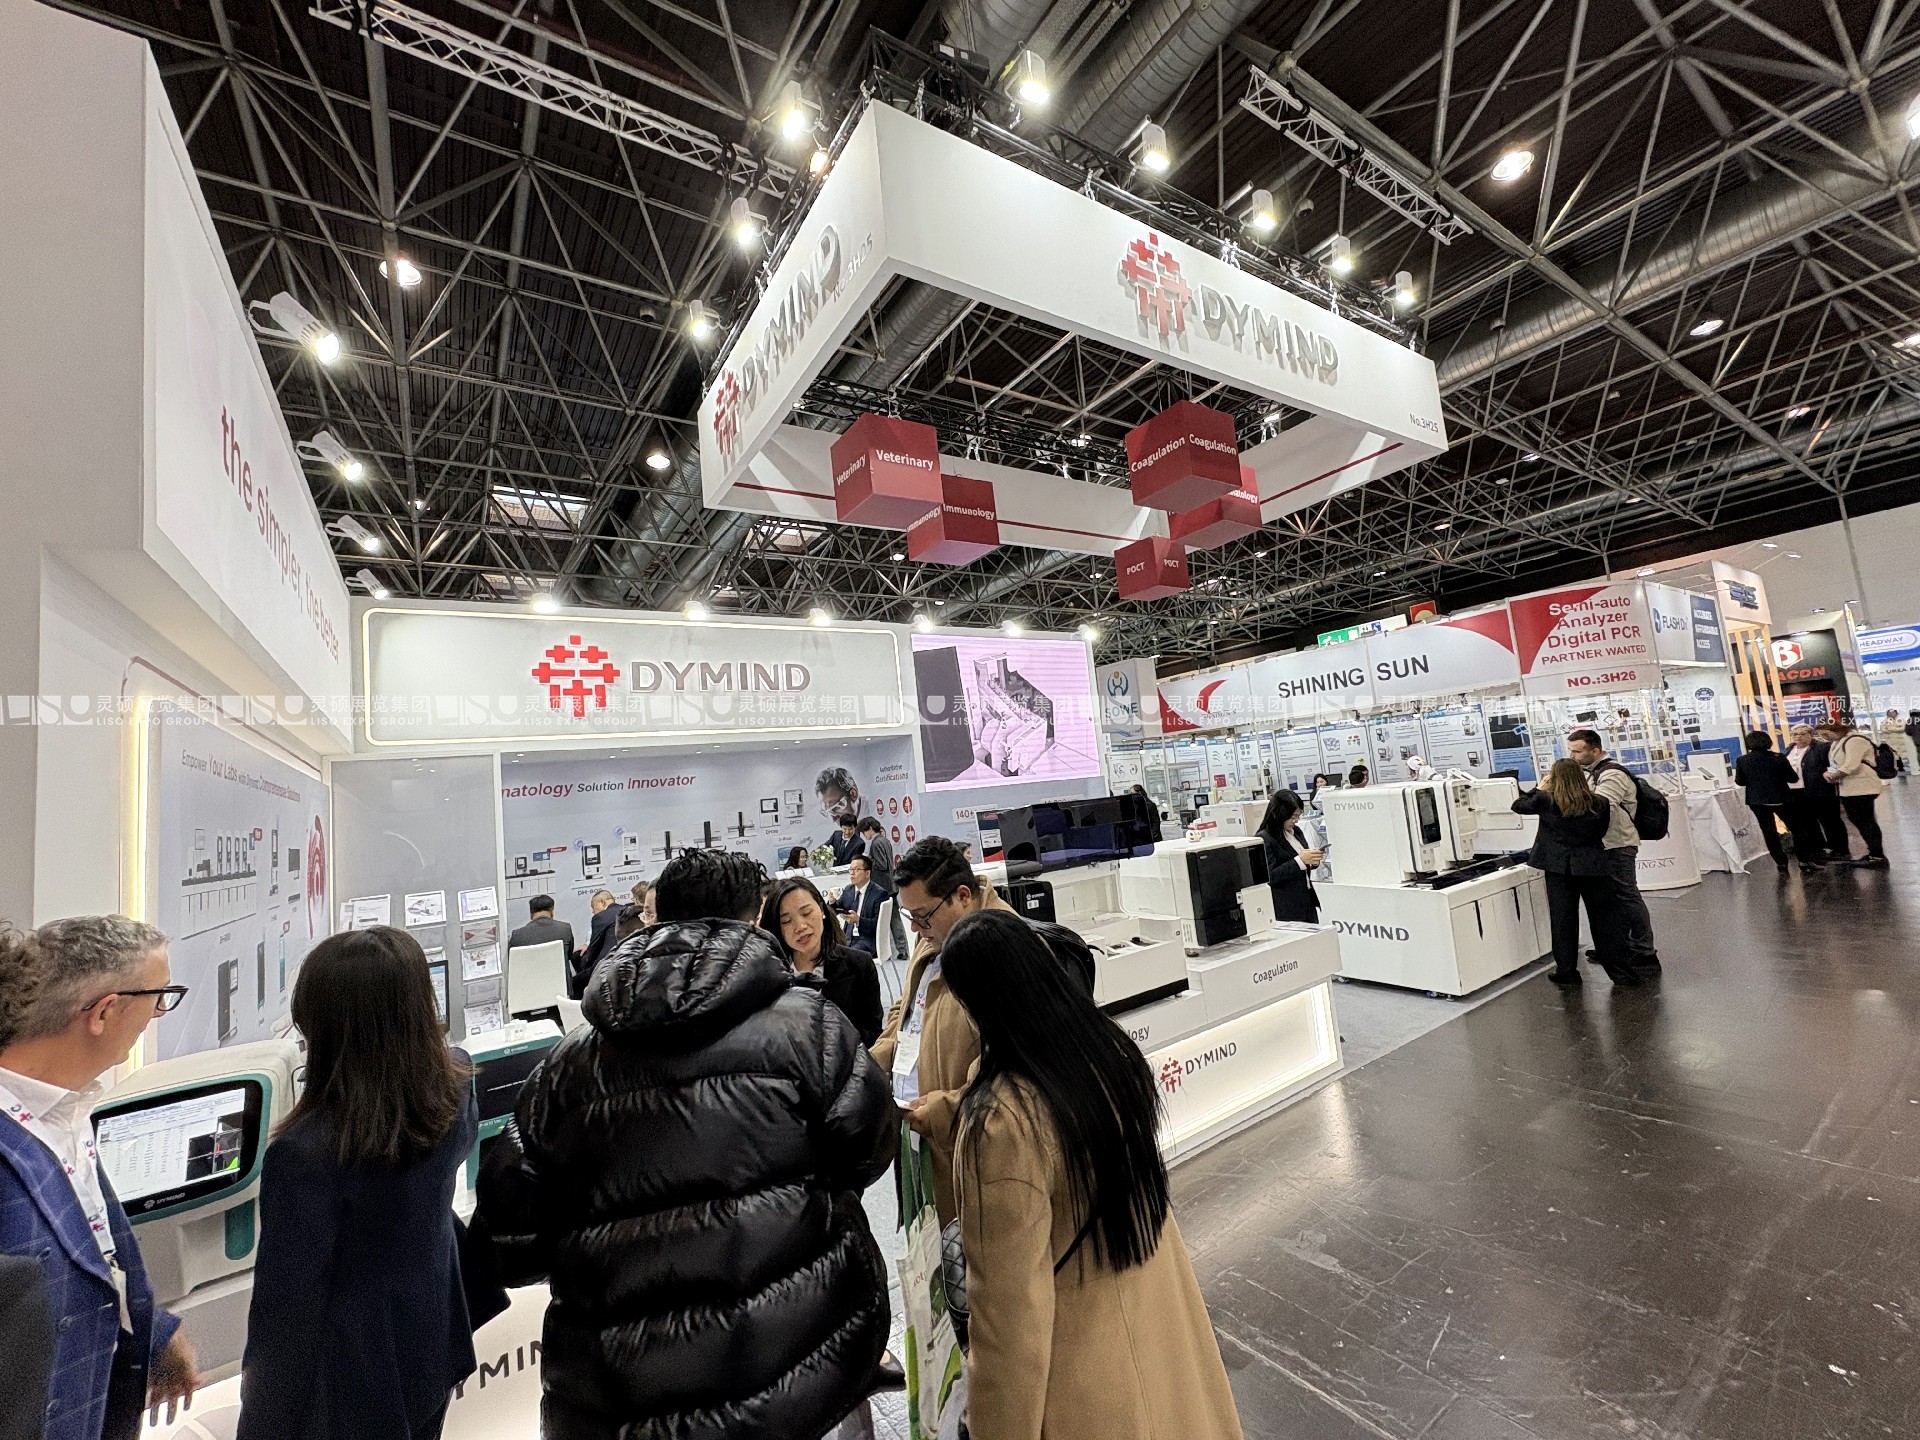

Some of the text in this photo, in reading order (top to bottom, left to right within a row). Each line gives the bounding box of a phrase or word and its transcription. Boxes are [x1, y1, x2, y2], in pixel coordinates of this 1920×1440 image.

[742, 225, 841, 405] DYMIND
[1200, 284, 1339, 375] DYMIND
[1410, 413, 1439, 433] No.3H25
[1131, 437, 1185, 472] Coagulation
[1189, 434, 1238, 456] Coagulation
[836, 454, 866, 485] Veterinary
[876, 449, 934, 471] Veterinary
[221, 404, 253, 512] the
[257, 486, 303, 613] simpler,
[943, 503, 995, 520] Immunology
[1127, 562, 1144, 575] POCT
[1164, 559, 1179, 569] POCT
[1549, 595, 1631, 616] Semi-auto
[1556, 611, 1629, 630] Analyzer
[1547, 625, 1641, 649] Digital PCR
[1859, 636, 1904, 648] HEADWAY
[1541, 644, 1647, 665] PARTNER WANTED
[630, 661, 811, 692] DYMIND
[1278, 654, 1430, 699] SHINING SUN
[1567, 670, 1637, 688] NO.:3H26
[1766, 666, 1826, 681] ACON
[181, 749, 207, 771] Empower
[208, 752, 224, 778] Your
[224, 759, 238, 782] Labs
[577, 781, 624, 793] Solution
[628, 775, 696, 790] Innovator
[1334, 801, 1375, 811] DYMIND
[1331, 920, 1410, 942] DYMIND
[1252, 959, 1299, 984] Coagulation
[1127, 1024, 1150, 1042] logy
[1185, 1042, 1237, 1076] DYMIND
